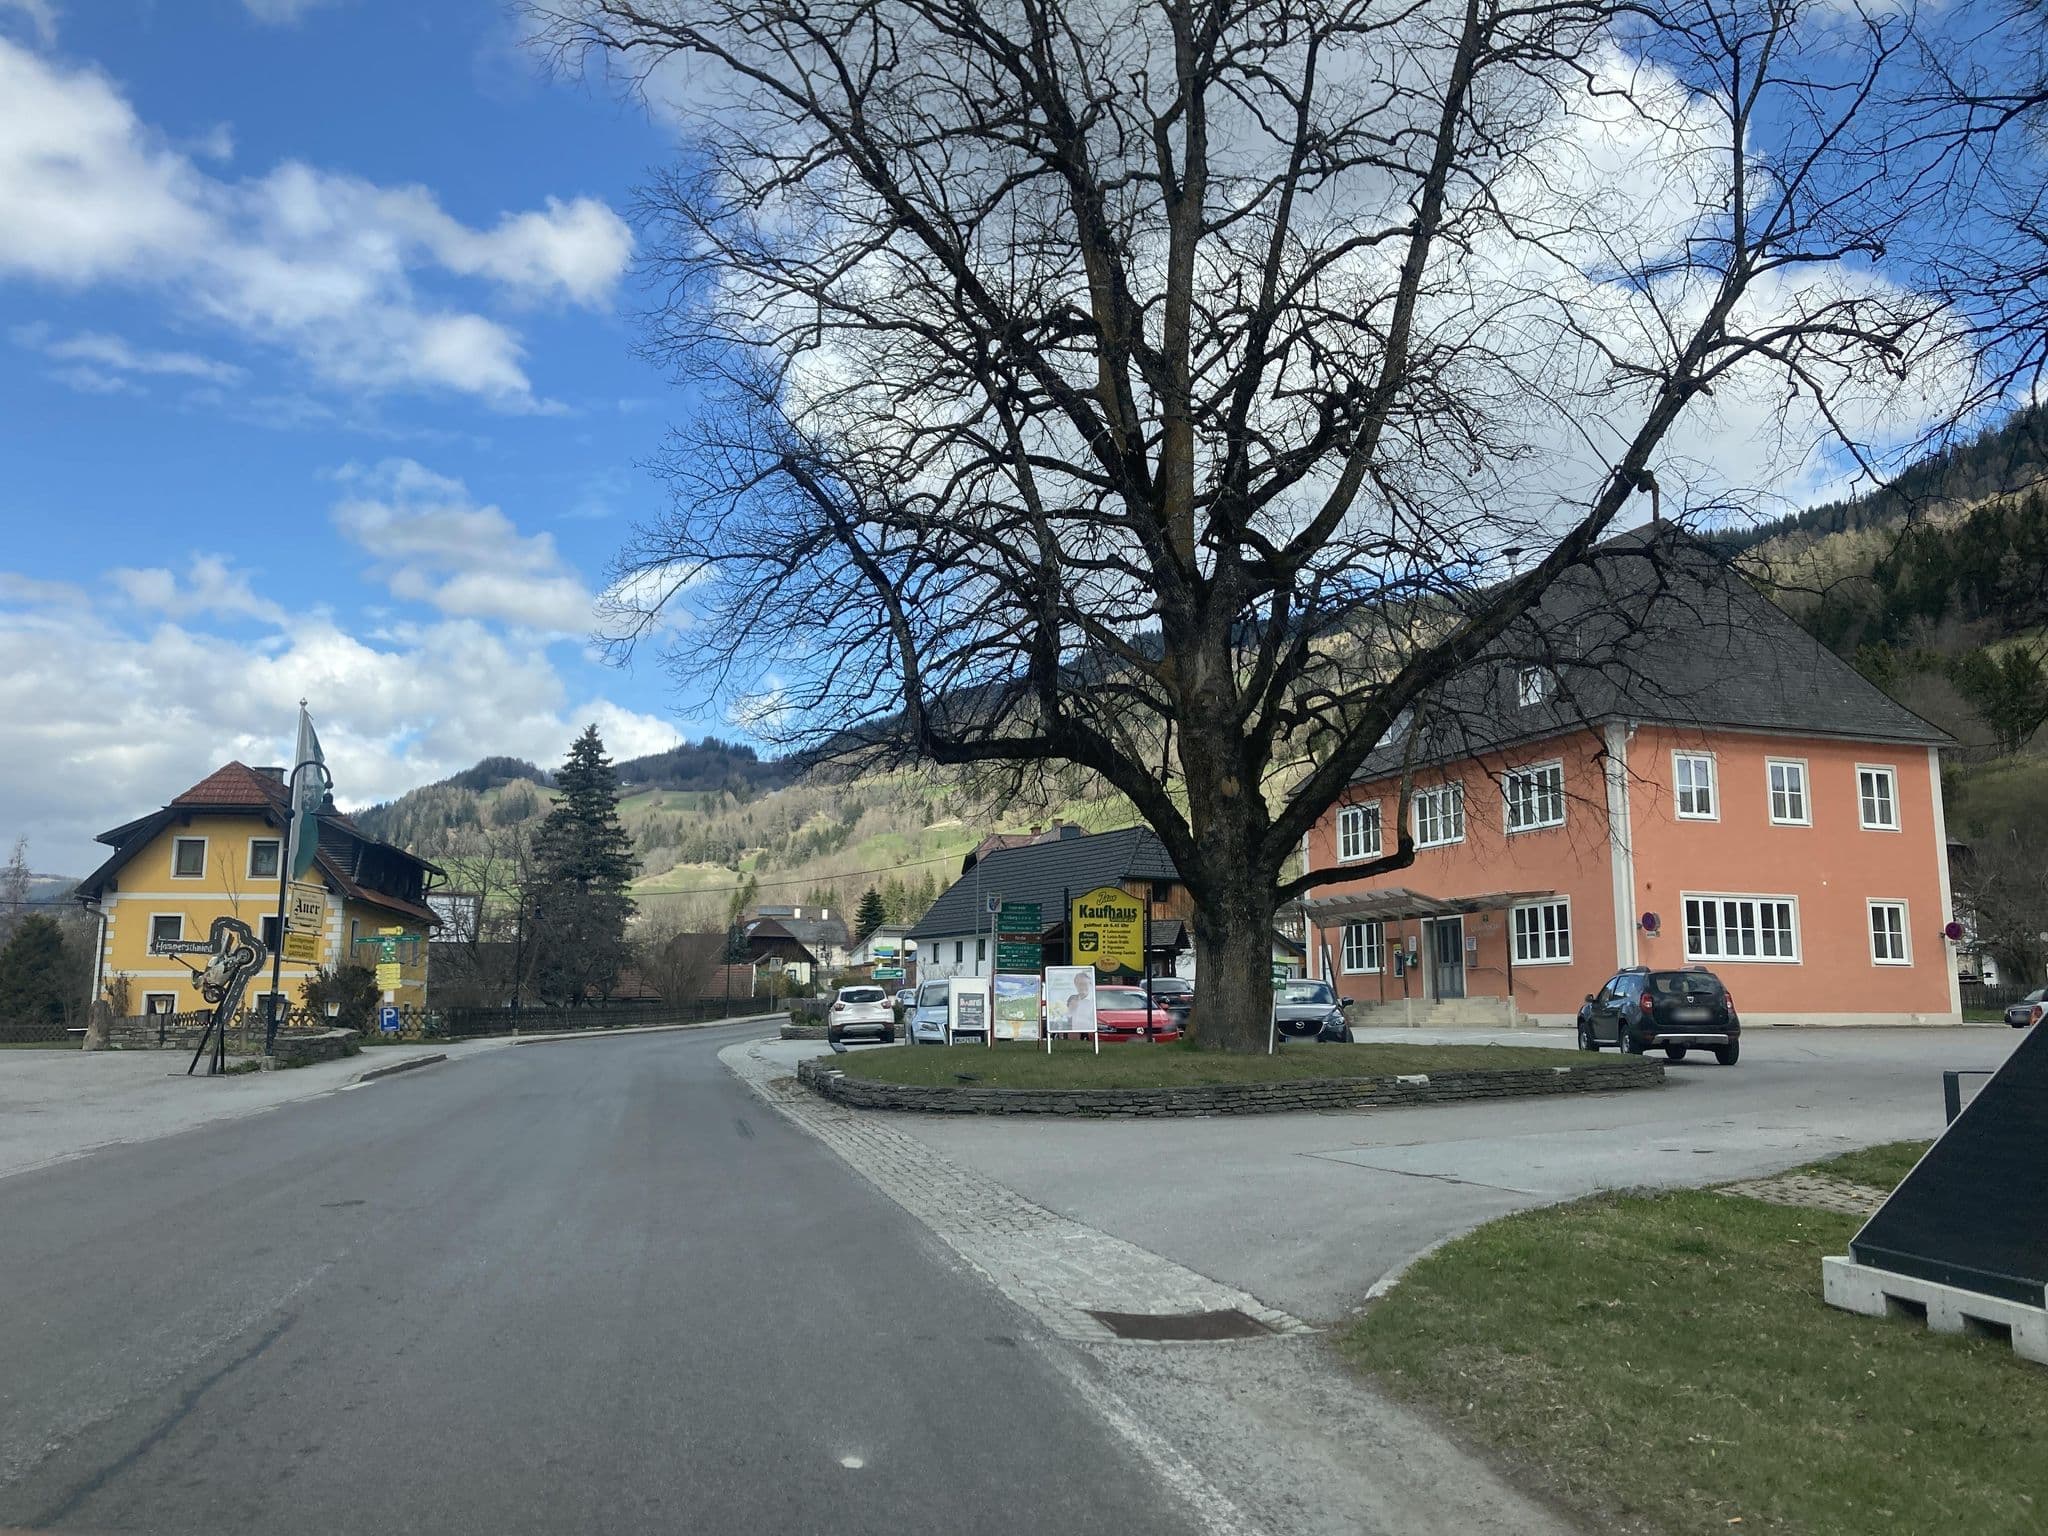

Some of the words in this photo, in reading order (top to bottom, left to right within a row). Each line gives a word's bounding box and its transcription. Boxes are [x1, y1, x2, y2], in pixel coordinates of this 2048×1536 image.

[294, 898, 320, 915] Auer
[1080, 905, 1137, 919] Kaufhaus
[383, 1008, 395, 1025] P
